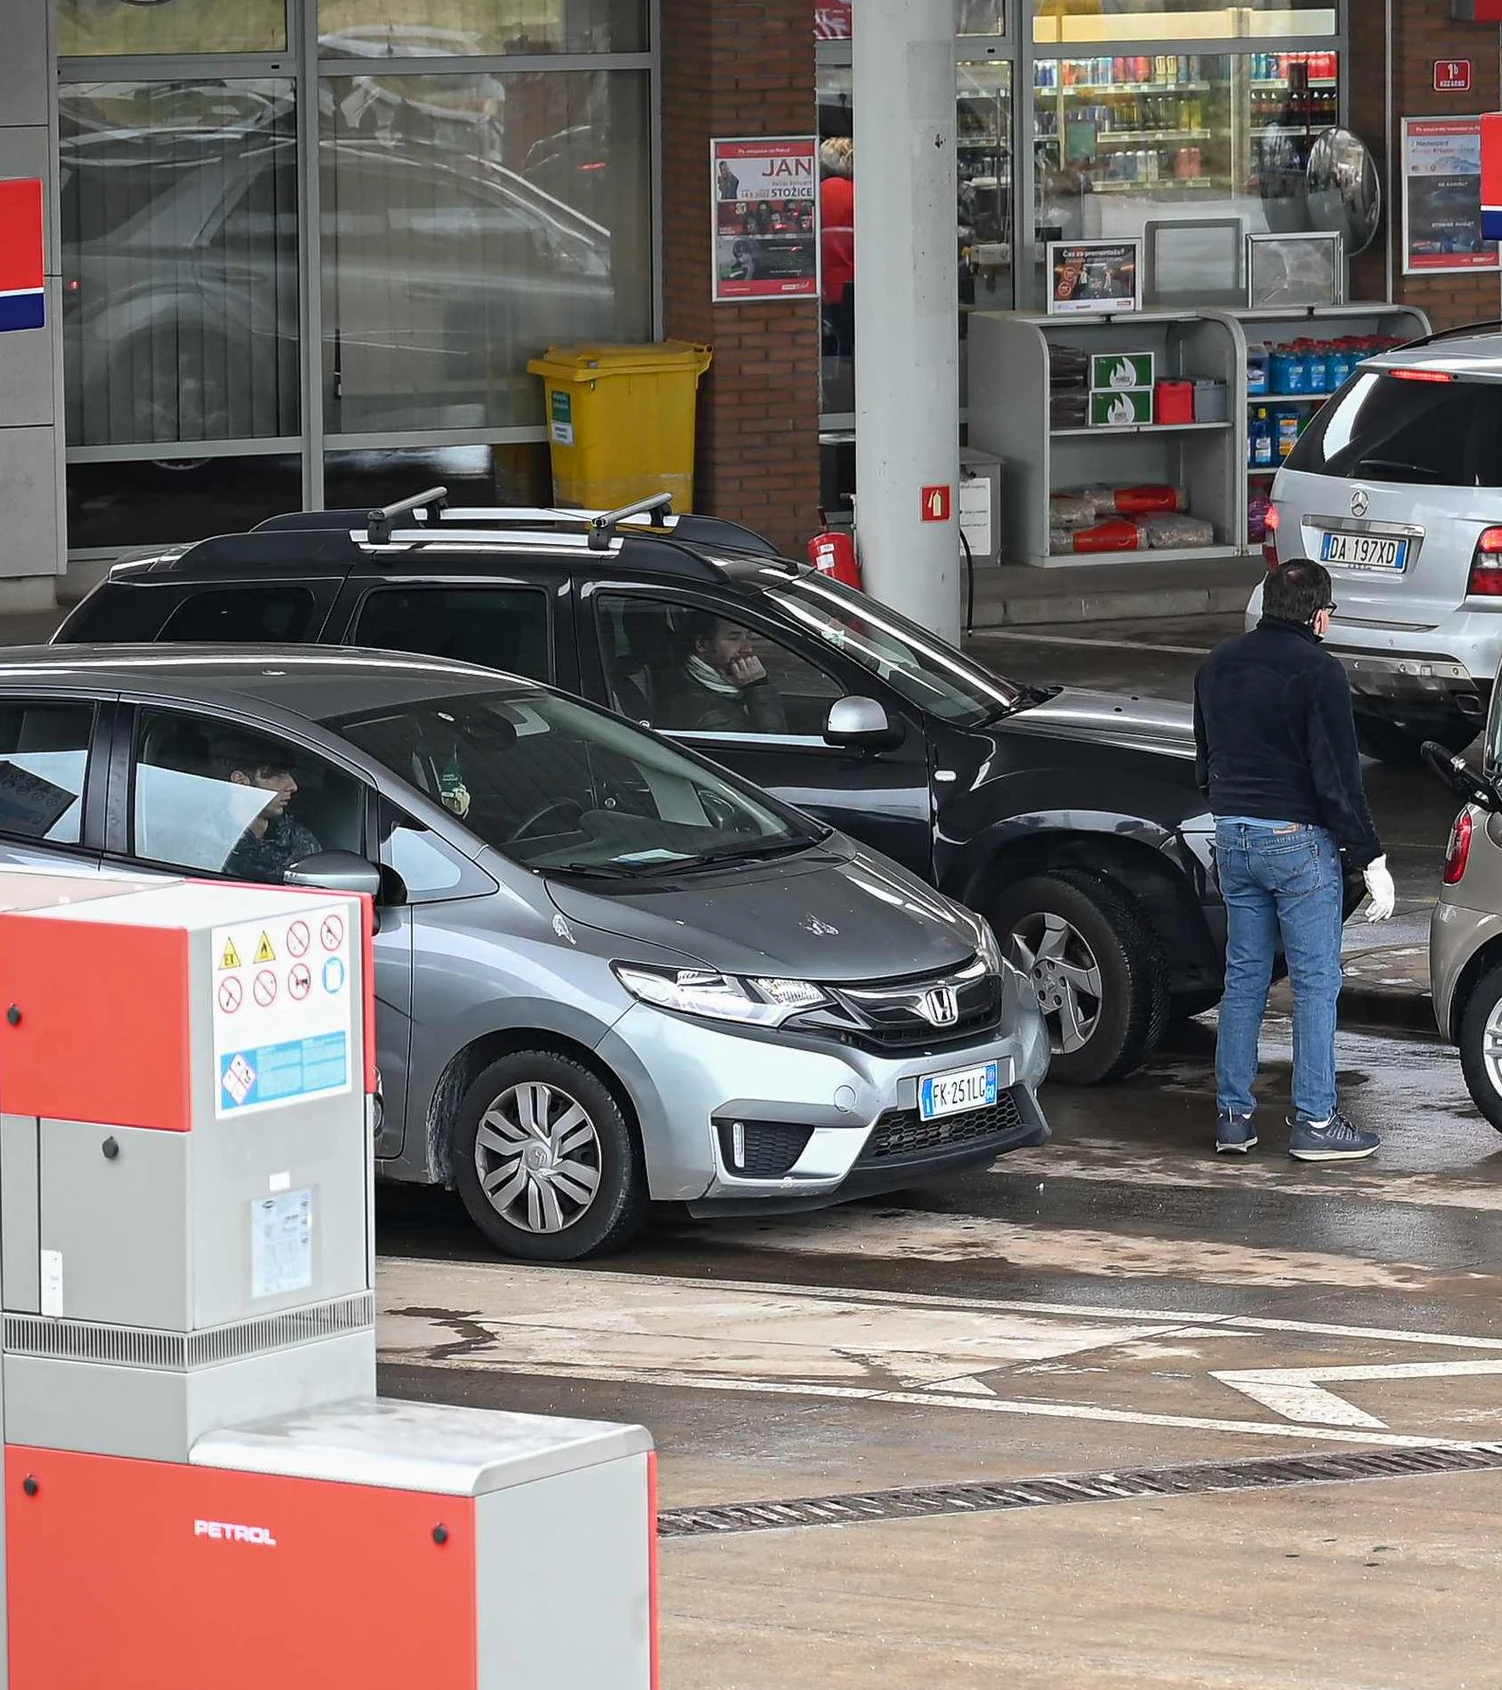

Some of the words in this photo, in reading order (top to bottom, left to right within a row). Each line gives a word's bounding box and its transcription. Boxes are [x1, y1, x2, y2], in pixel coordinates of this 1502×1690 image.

[762, 158, 812, 177] JAN
[771, 186, 813, 198] STOŽICE
[1329, 536, 1346, 560] DA
[1353, 538, 1396, 565] 197XD
[933, 1083, 947, 1108] FK
[951, 1075, 986, 1105] 251LG
[193, 1519, 277, 1546] PETROL
